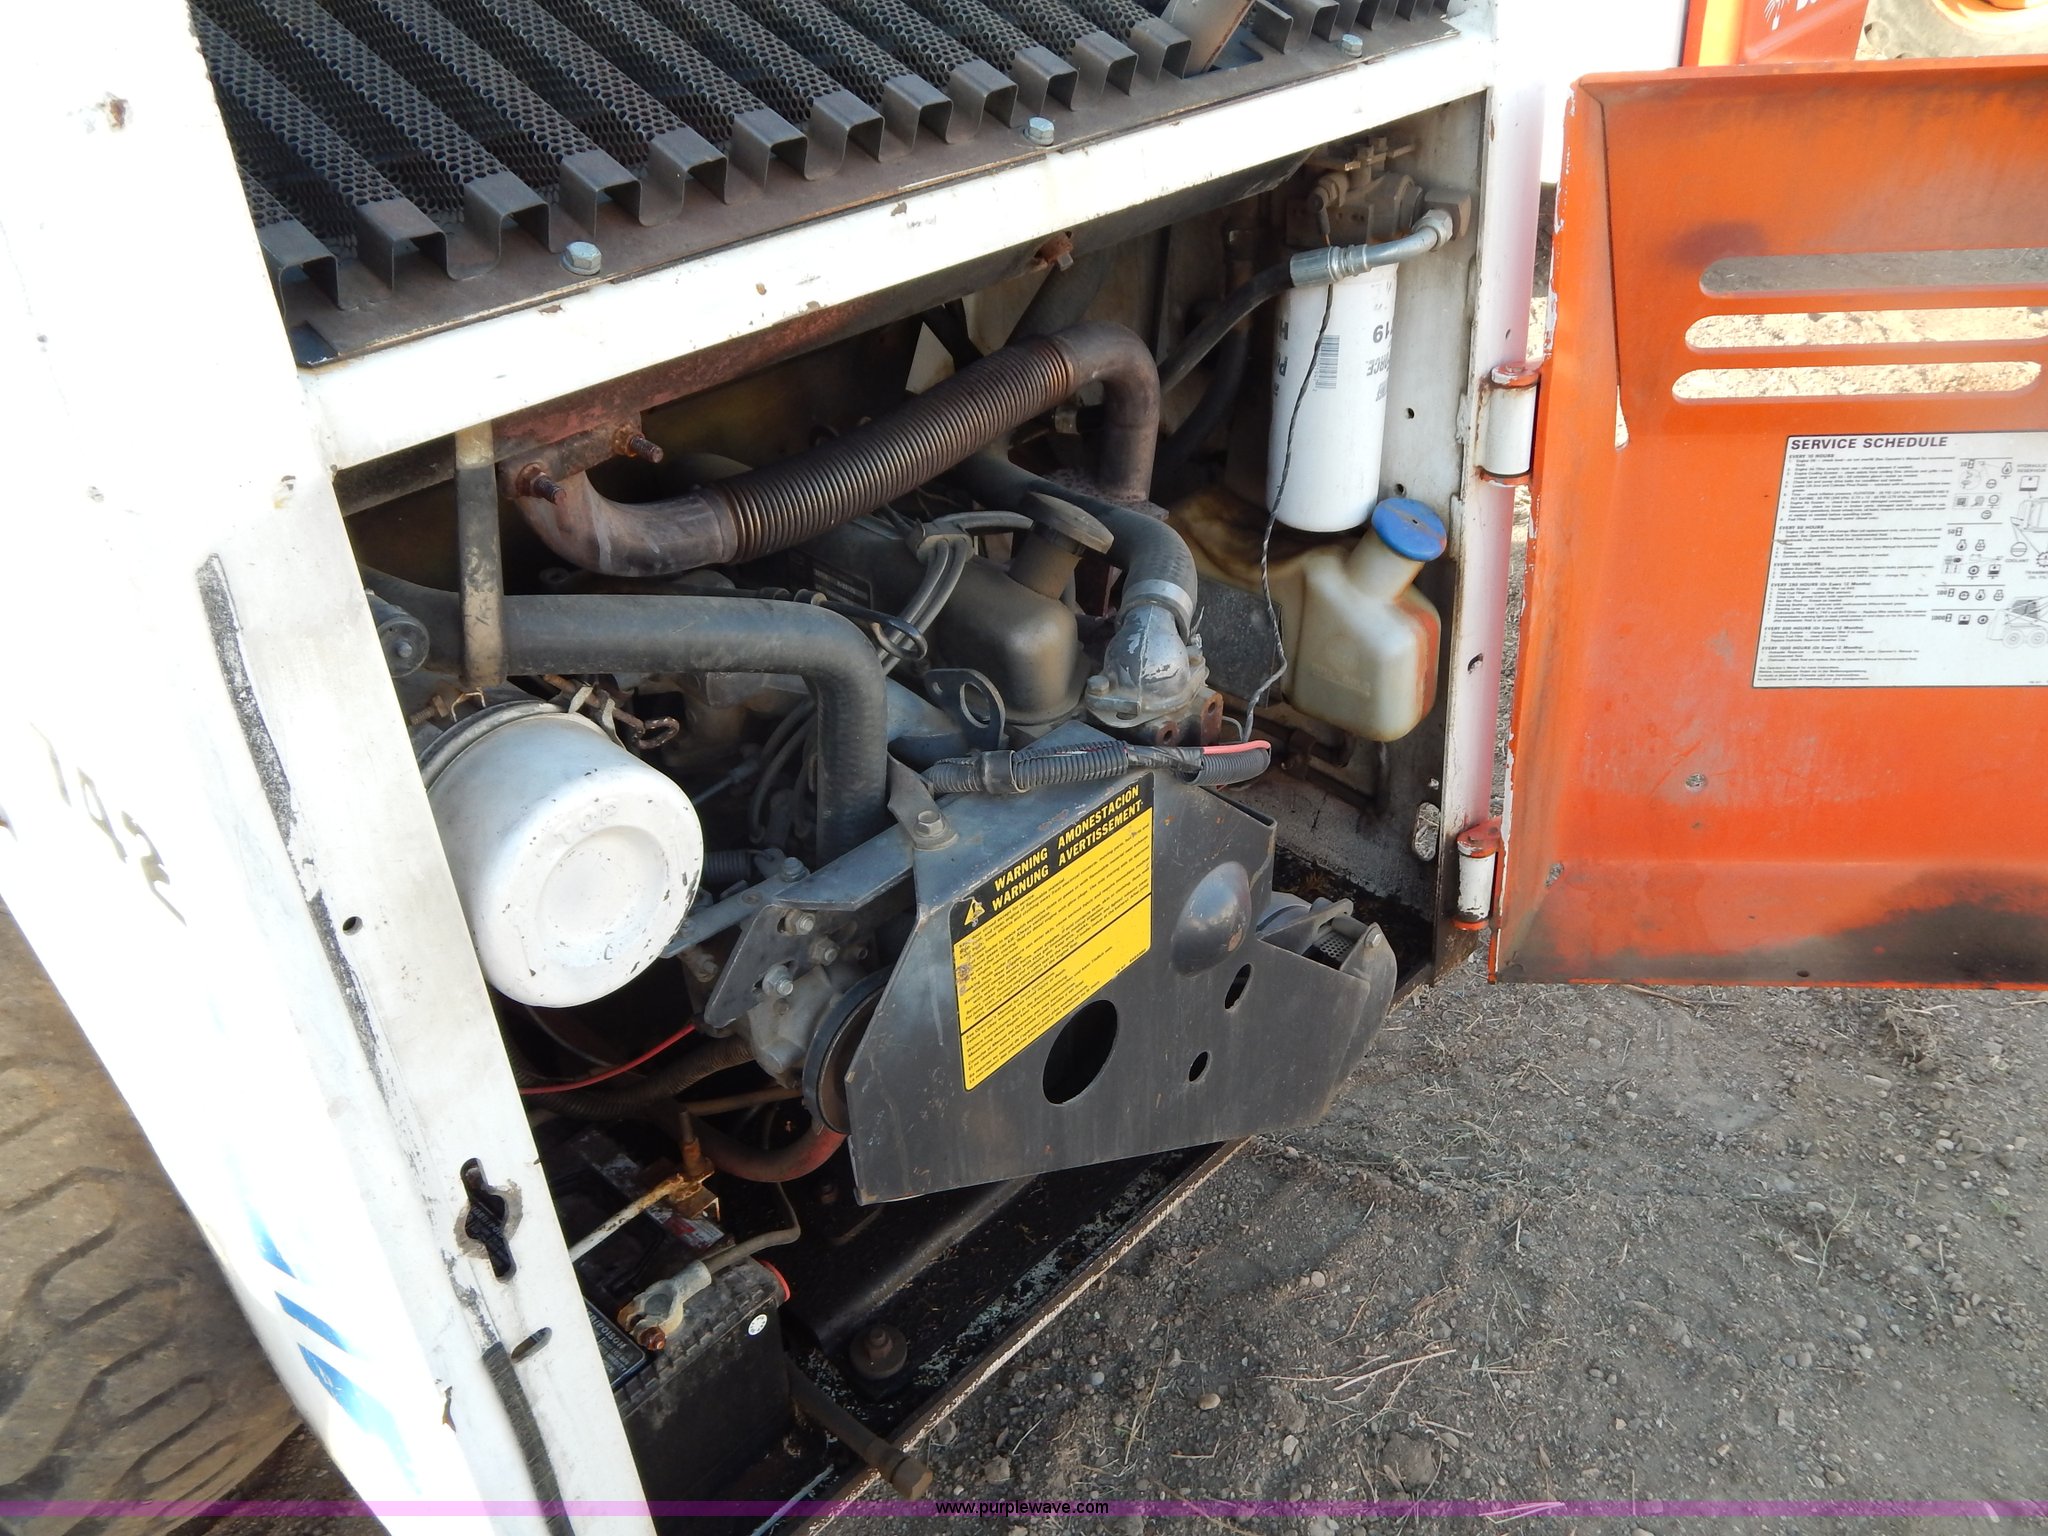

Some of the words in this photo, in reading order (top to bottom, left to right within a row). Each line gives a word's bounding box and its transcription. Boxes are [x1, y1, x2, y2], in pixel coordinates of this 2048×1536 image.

[1791, 439, 1857, 450] SERVICE
[1863, 437, 1948, 449] SCHEDULE
[991, 864, 1050, 911] WARNUNG
[1058, 800, 1141, 866] AVERTISSEMENT
[994, 846, 1049, 892] WARNING
